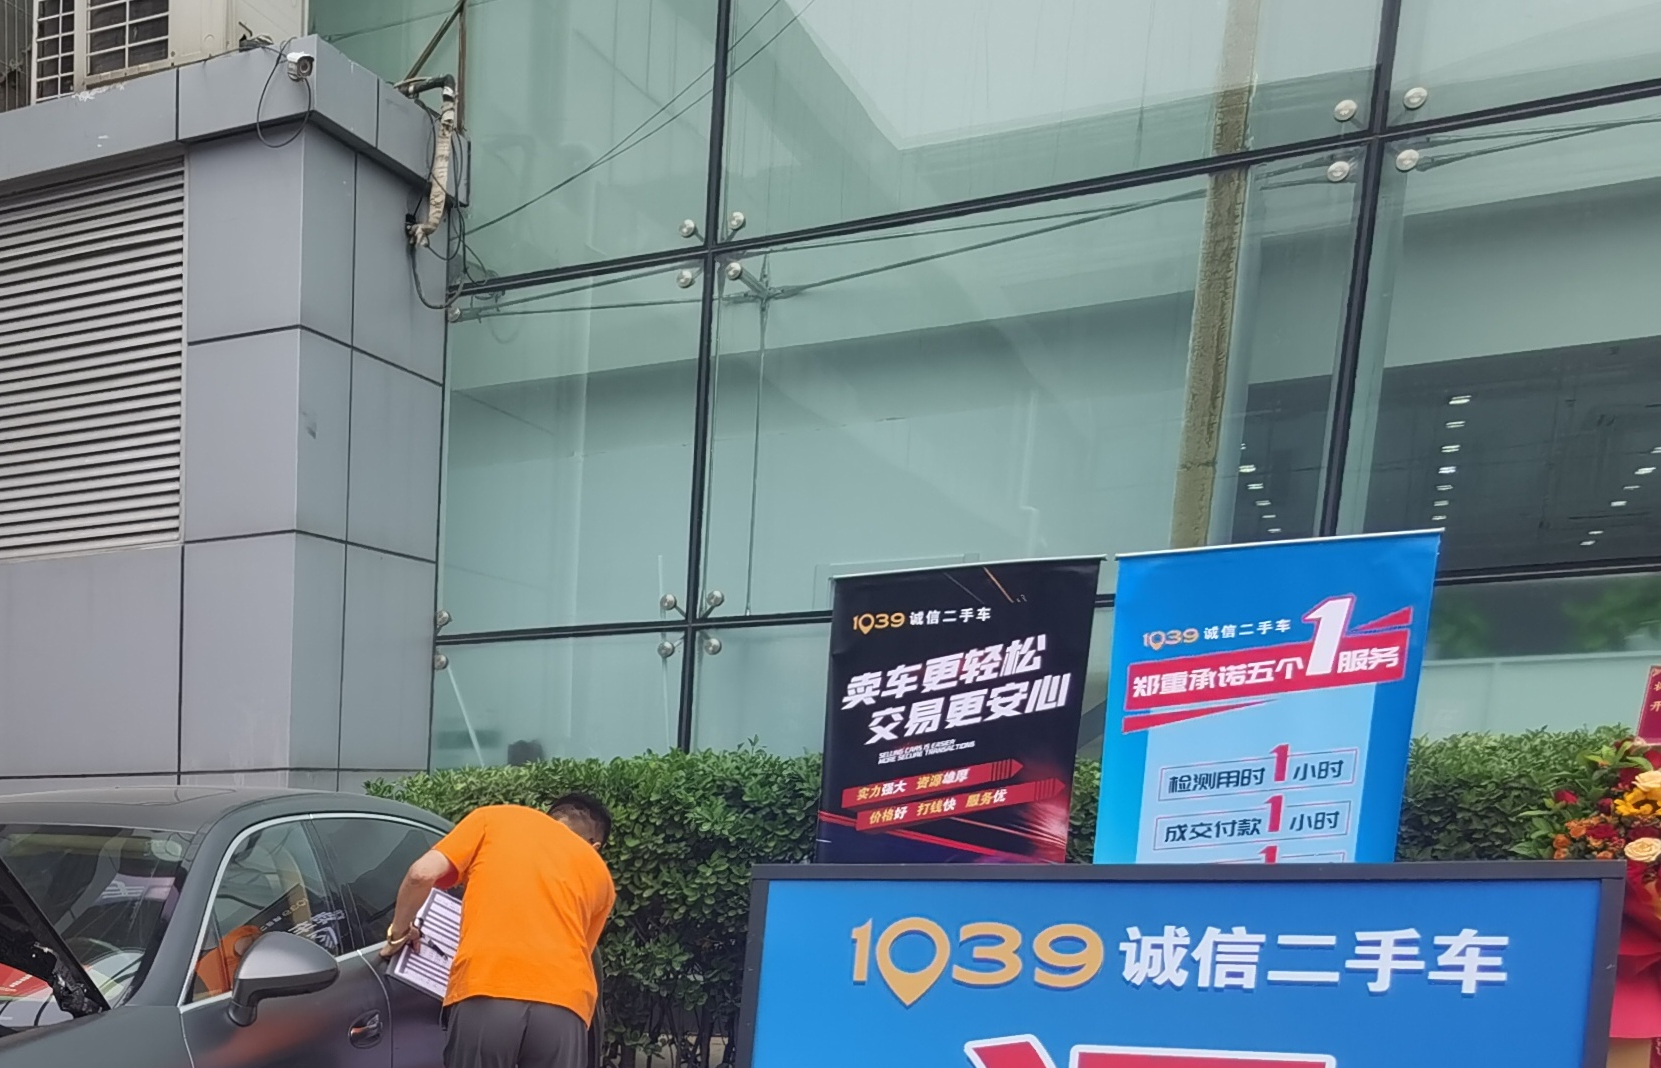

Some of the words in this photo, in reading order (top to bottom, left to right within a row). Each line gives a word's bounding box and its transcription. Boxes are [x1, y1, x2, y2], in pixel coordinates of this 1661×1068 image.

[852, 611, 906, 635] 1039
[909, 606, 992, 626] 诚信二手车
[1142, 627, 1200, 651] 1039
[1203, 618, 1292, 641] 诚信二手车
[840, 633, 1047, 711] 卖车更轻松
[863, 672, 1073, 746] 交易更安心
[856, 780, 907, 801] 实力强大
[915, 768, 971, 790] 资源雄厚
[868, 805, 908, 825] 价格好
[965, 788, 1008, 808] 服务优
[850, 916, 1105, 1007] 1039
[1118, 925, 1510, 997] 诚信二手车
